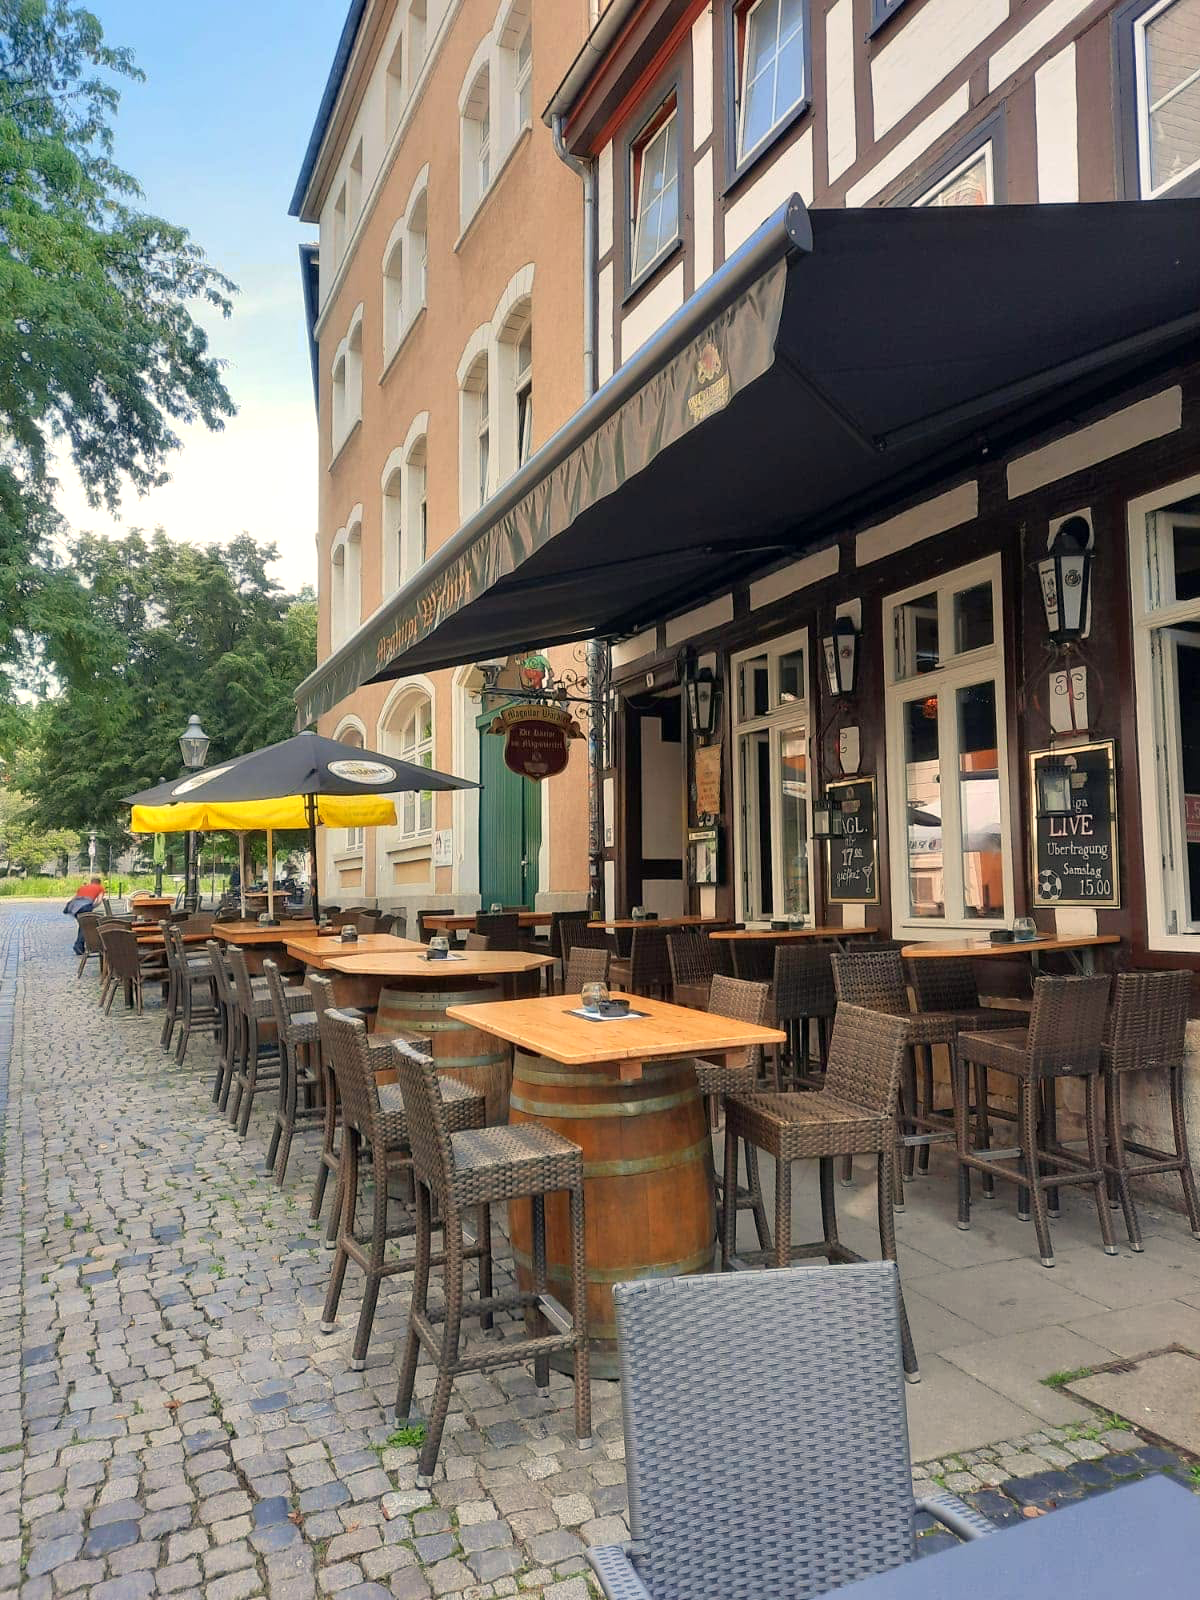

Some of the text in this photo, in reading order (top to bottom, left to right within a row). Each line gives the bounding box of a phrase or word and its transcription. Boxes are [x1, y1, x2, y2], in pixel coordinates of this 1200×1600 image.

[1049, 814, 1094, 837] LIVE
[1063, 862, 1102, 878] Samstag
[1080, 879, 1111, 896] 15.00
